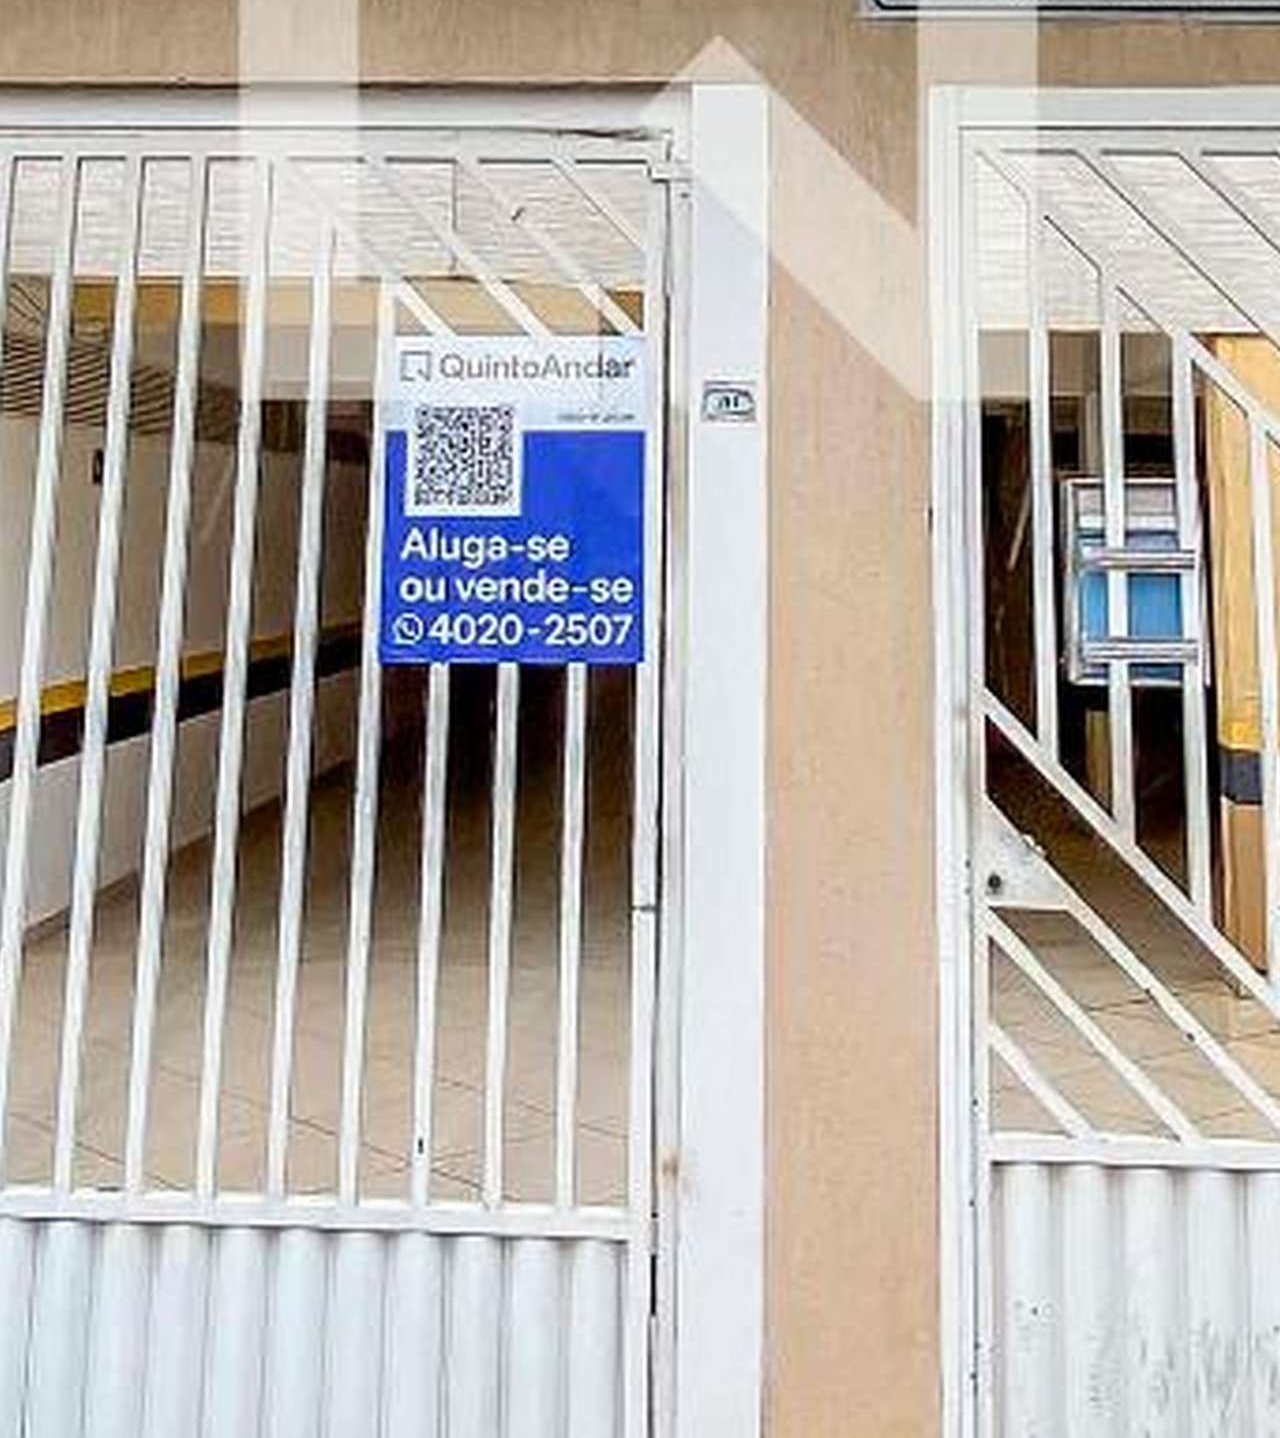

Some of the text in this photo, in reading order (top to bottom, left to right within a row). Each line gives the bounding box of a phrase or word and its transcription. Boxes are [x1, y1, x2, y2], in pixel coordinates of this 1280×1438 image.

[439, 351, 635, 381] QuintoAndar
[400, 528, 570, 568] Aluga-se
[399, 569, 634, 603] ou vende-se
[428, 614, 634, 646] 4020-2507
